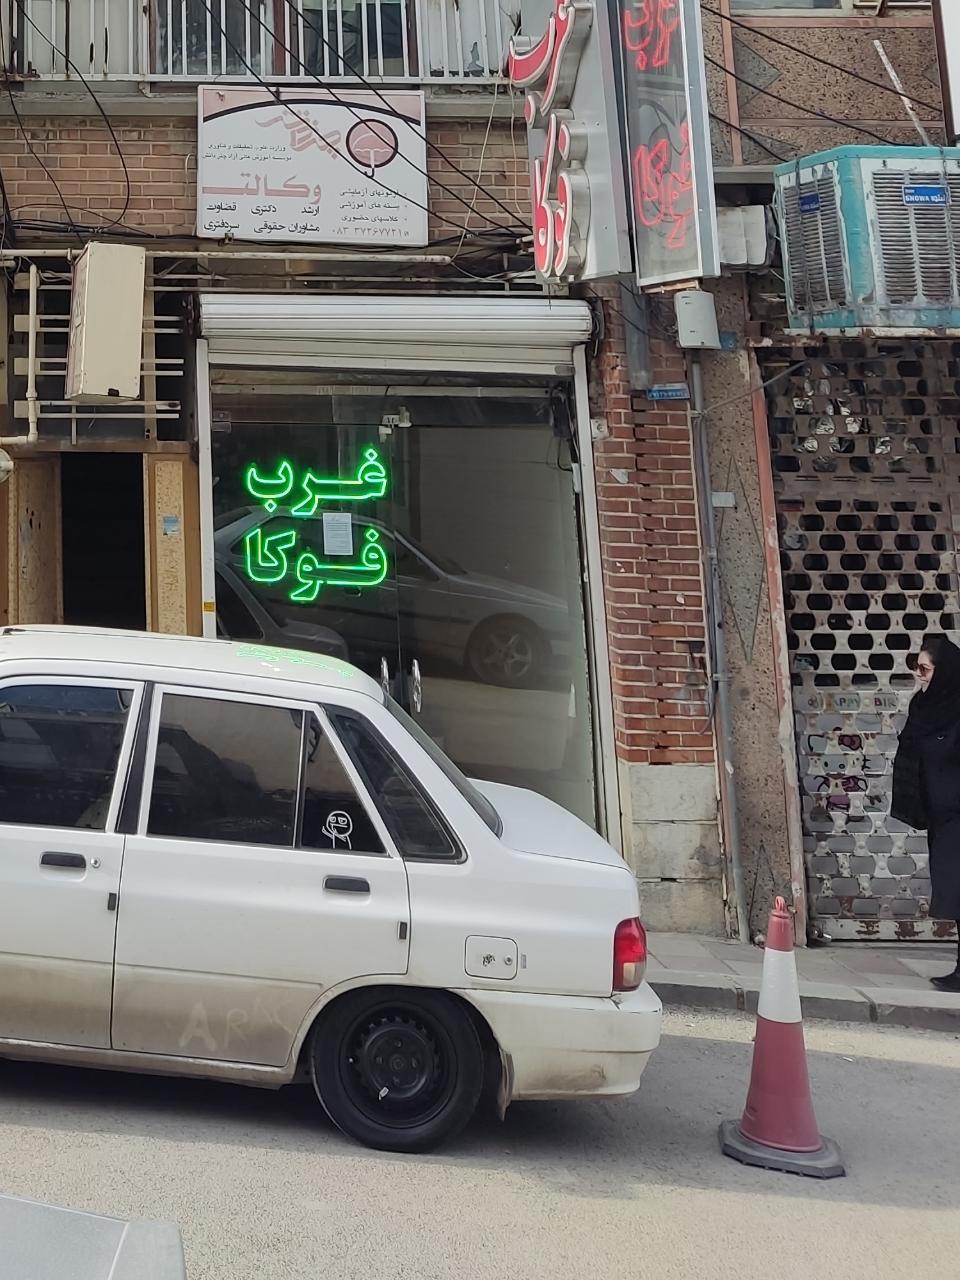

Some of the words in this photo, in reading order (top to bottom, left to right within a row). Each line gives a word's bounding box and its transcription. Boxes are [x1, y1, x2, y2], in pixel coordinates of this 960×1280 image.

[206, 202, 237, 213] قضاوت
[250, 204, 277, 216] دکتری
[301, 205, 320, 216] ارشد
[203, 220, 240, 233] سردفتری
[253, 222, 286, 233] حقوقی
[288, 222, 320, 234] مشاوران
[246, 448, 388, 516] غرب
[245, 528, 388, 601] فوکا
